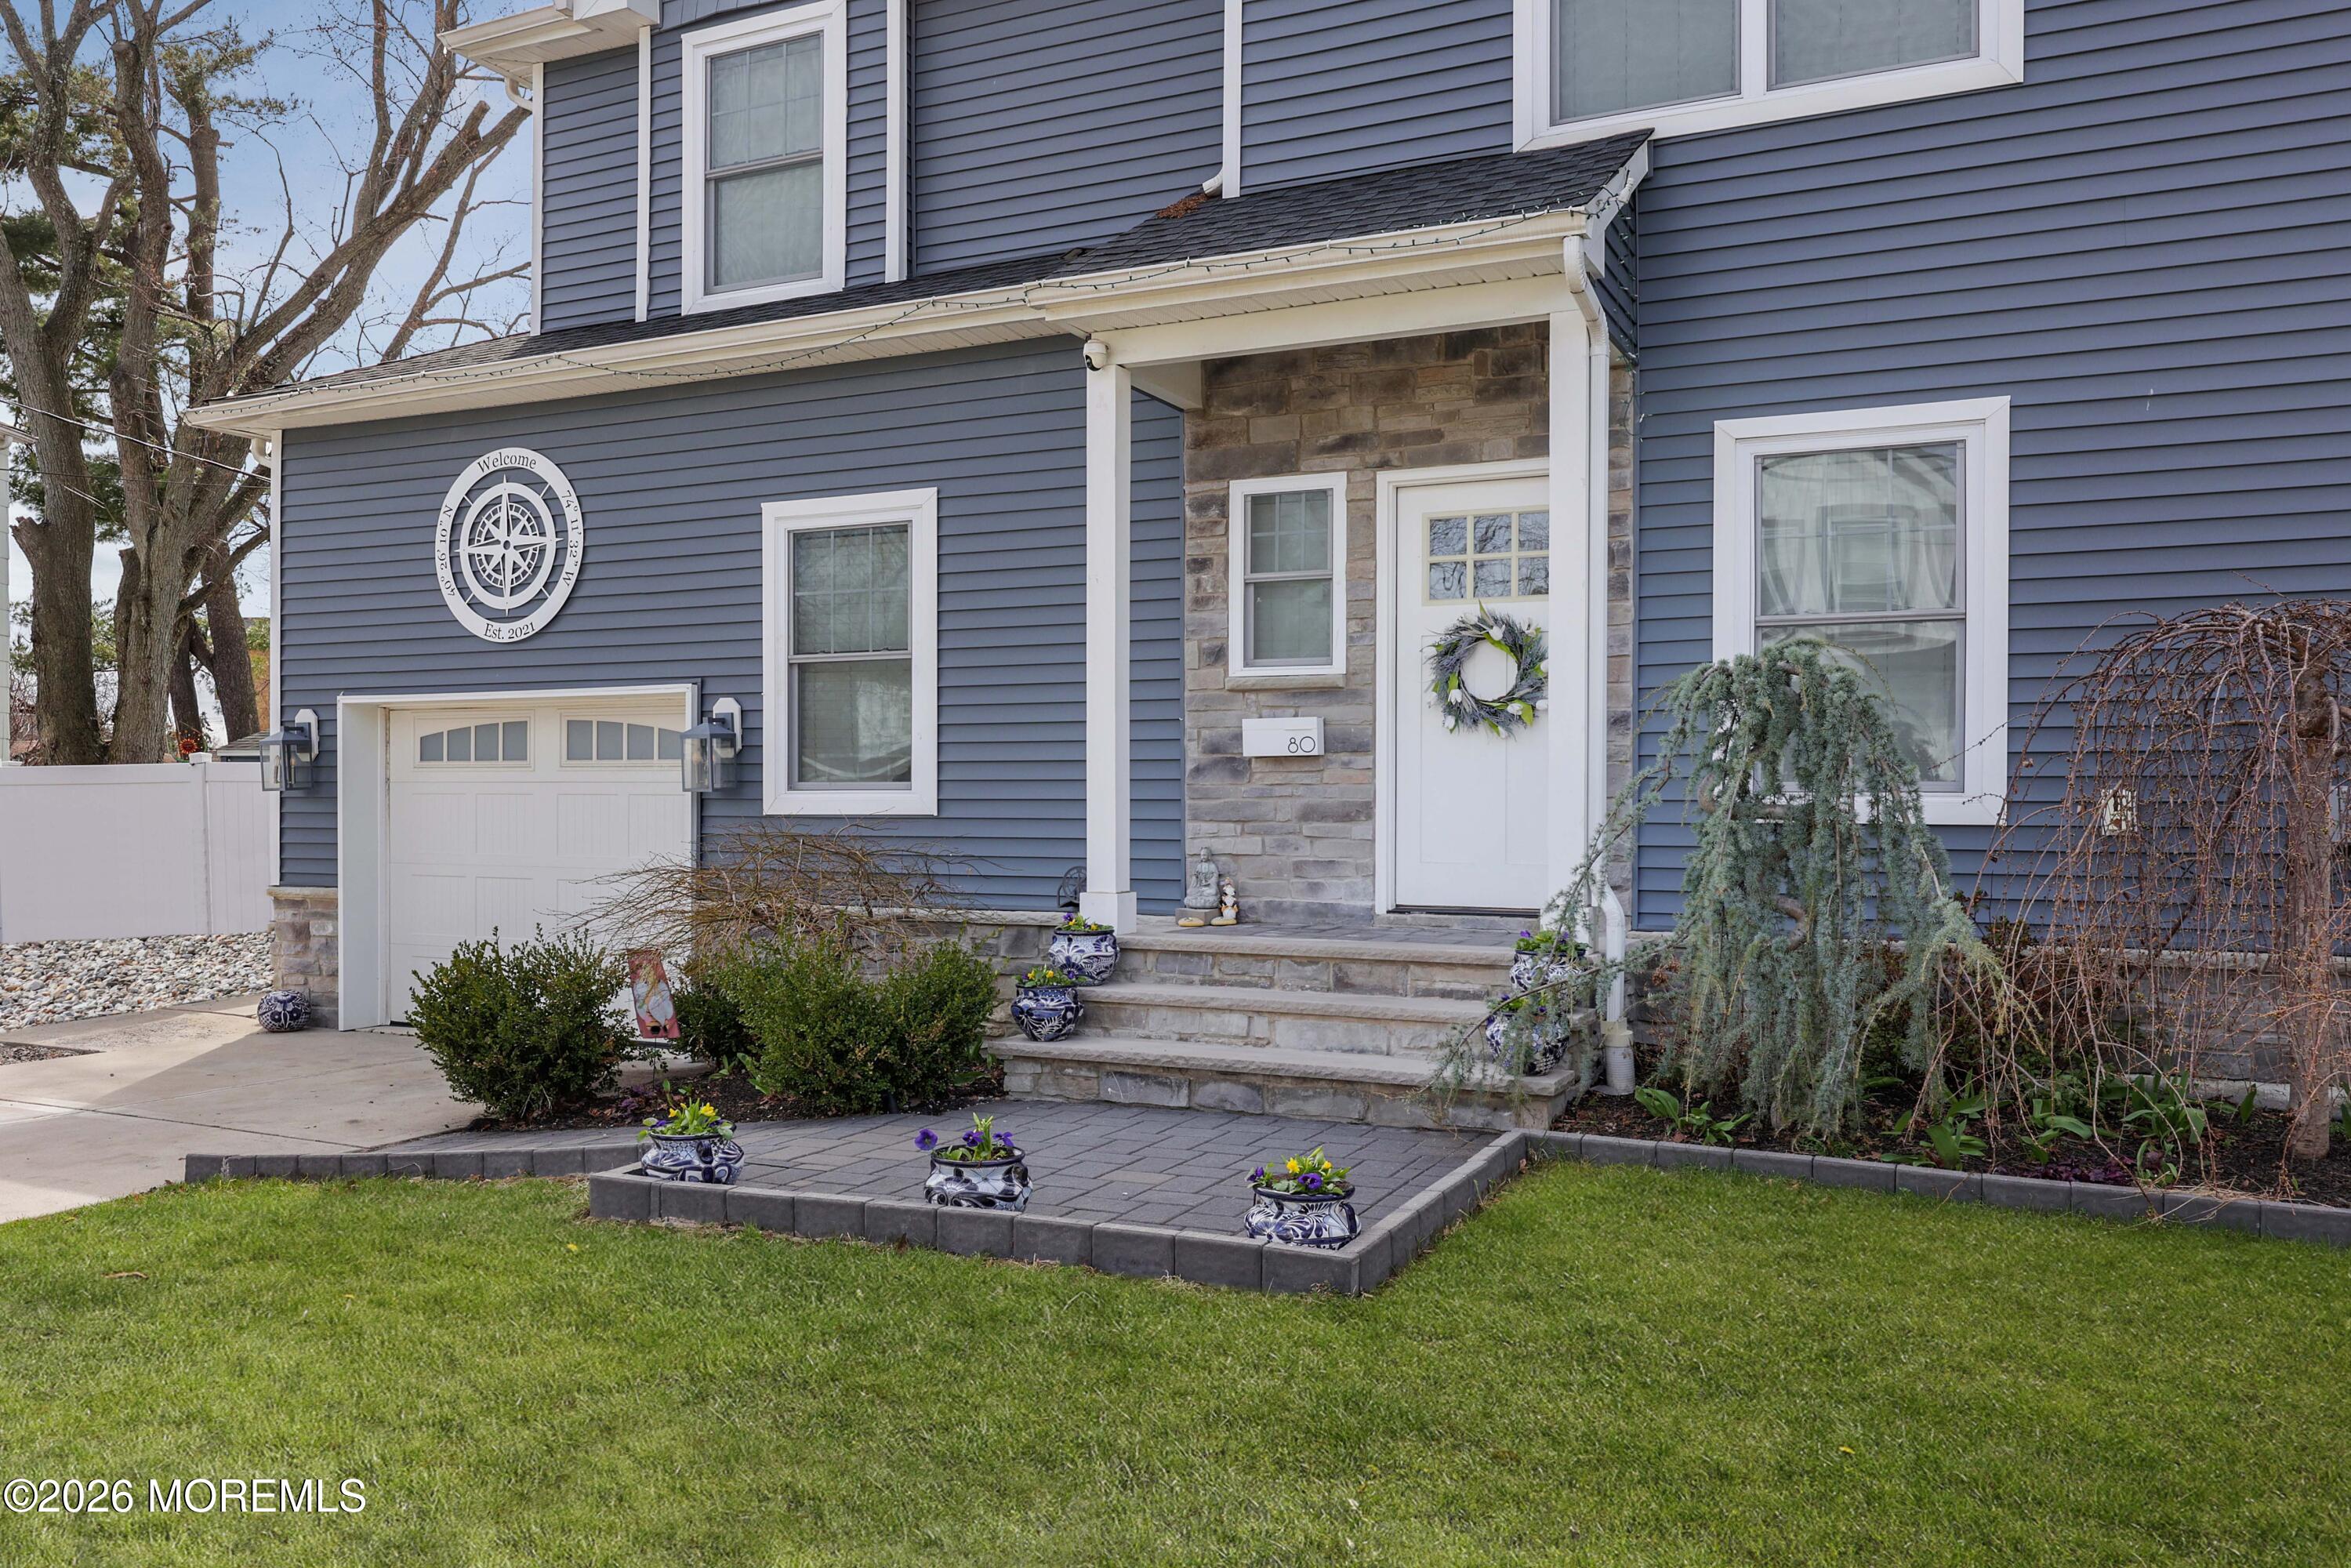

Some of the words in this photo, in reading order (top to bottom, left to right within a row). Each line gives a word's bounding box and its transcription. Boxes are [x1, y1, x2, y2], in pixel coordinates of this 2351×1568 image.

[477, 452, 536, 473] Welcome
[444, 504, 454, 518] N
[562, 571, 574, 586] W
[484, 623, 505, 640] Est.
[508, 622, 535, 639] 2021
[1288, 736, 1315, 753] 80
